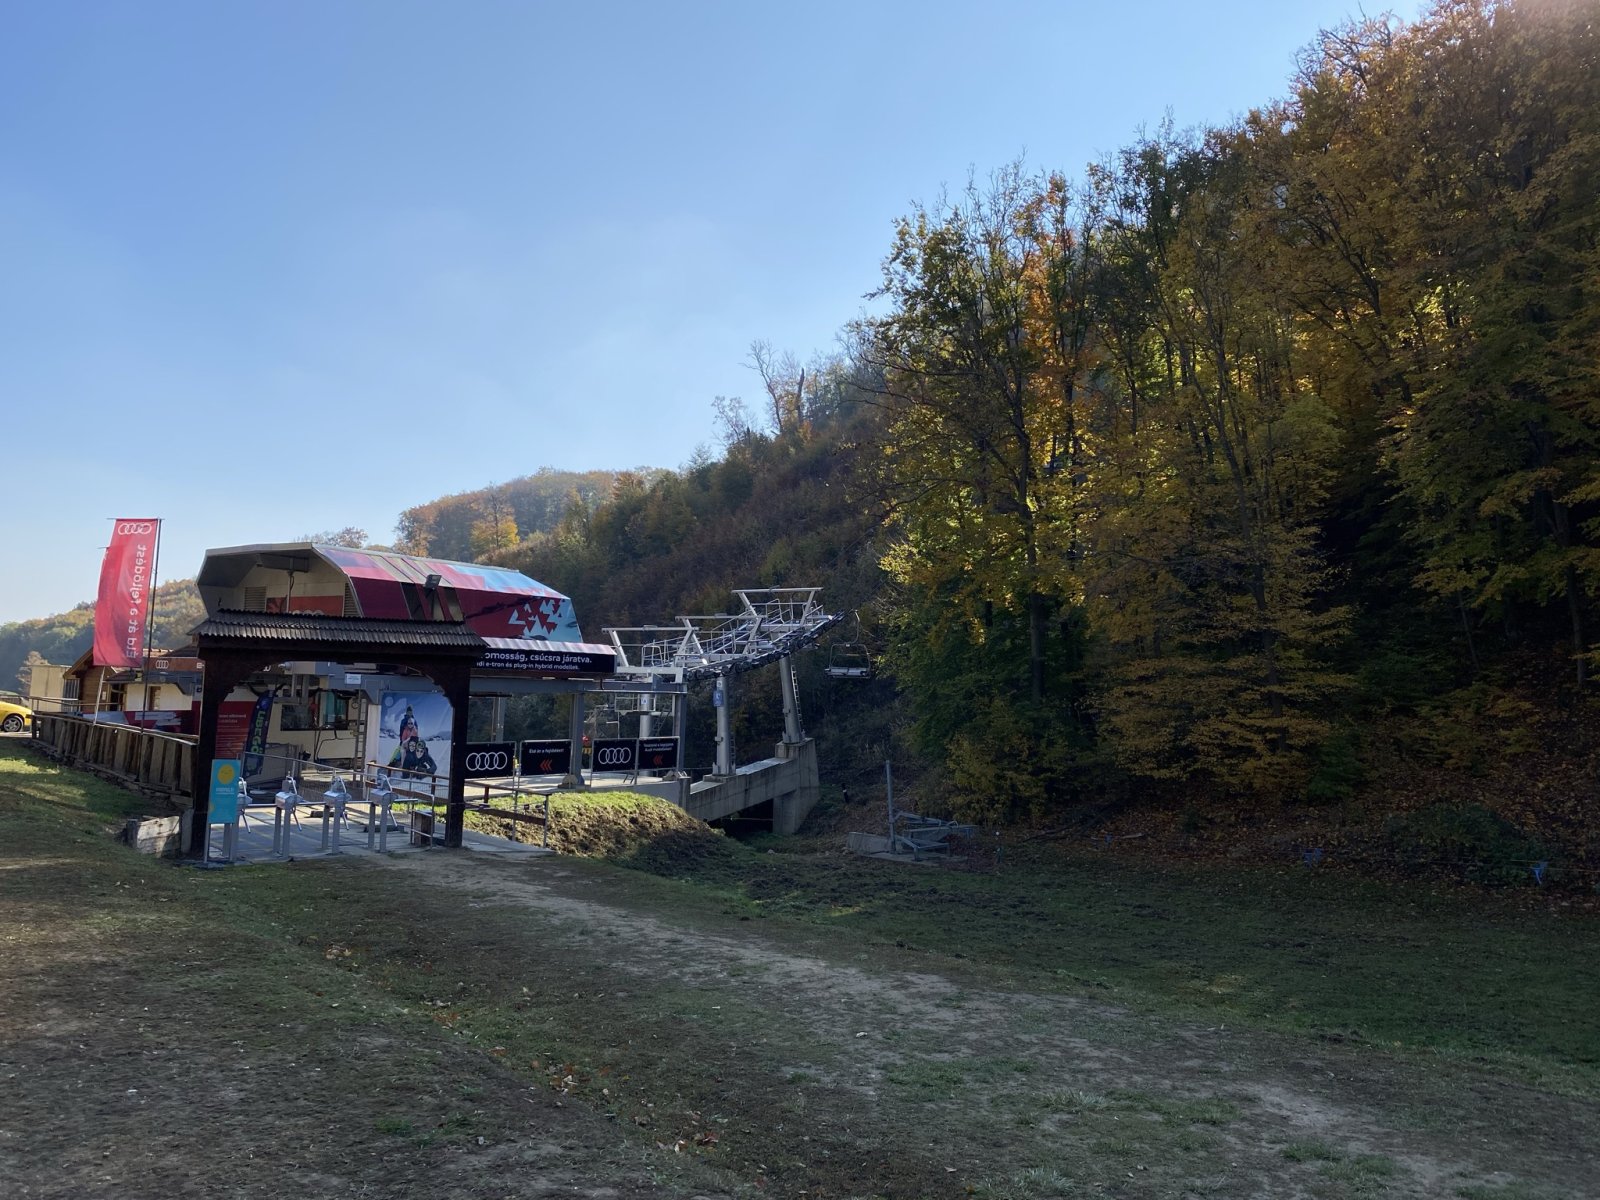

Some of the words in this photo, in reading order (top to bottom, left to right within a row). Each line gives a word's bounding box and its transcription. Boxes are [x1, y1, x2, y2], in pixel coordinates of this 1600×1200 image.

[484, 652, 528, 662] omosság,
[529, 653, 561, 662] csúcsra
[562, 655, 593, 664] járatva.
